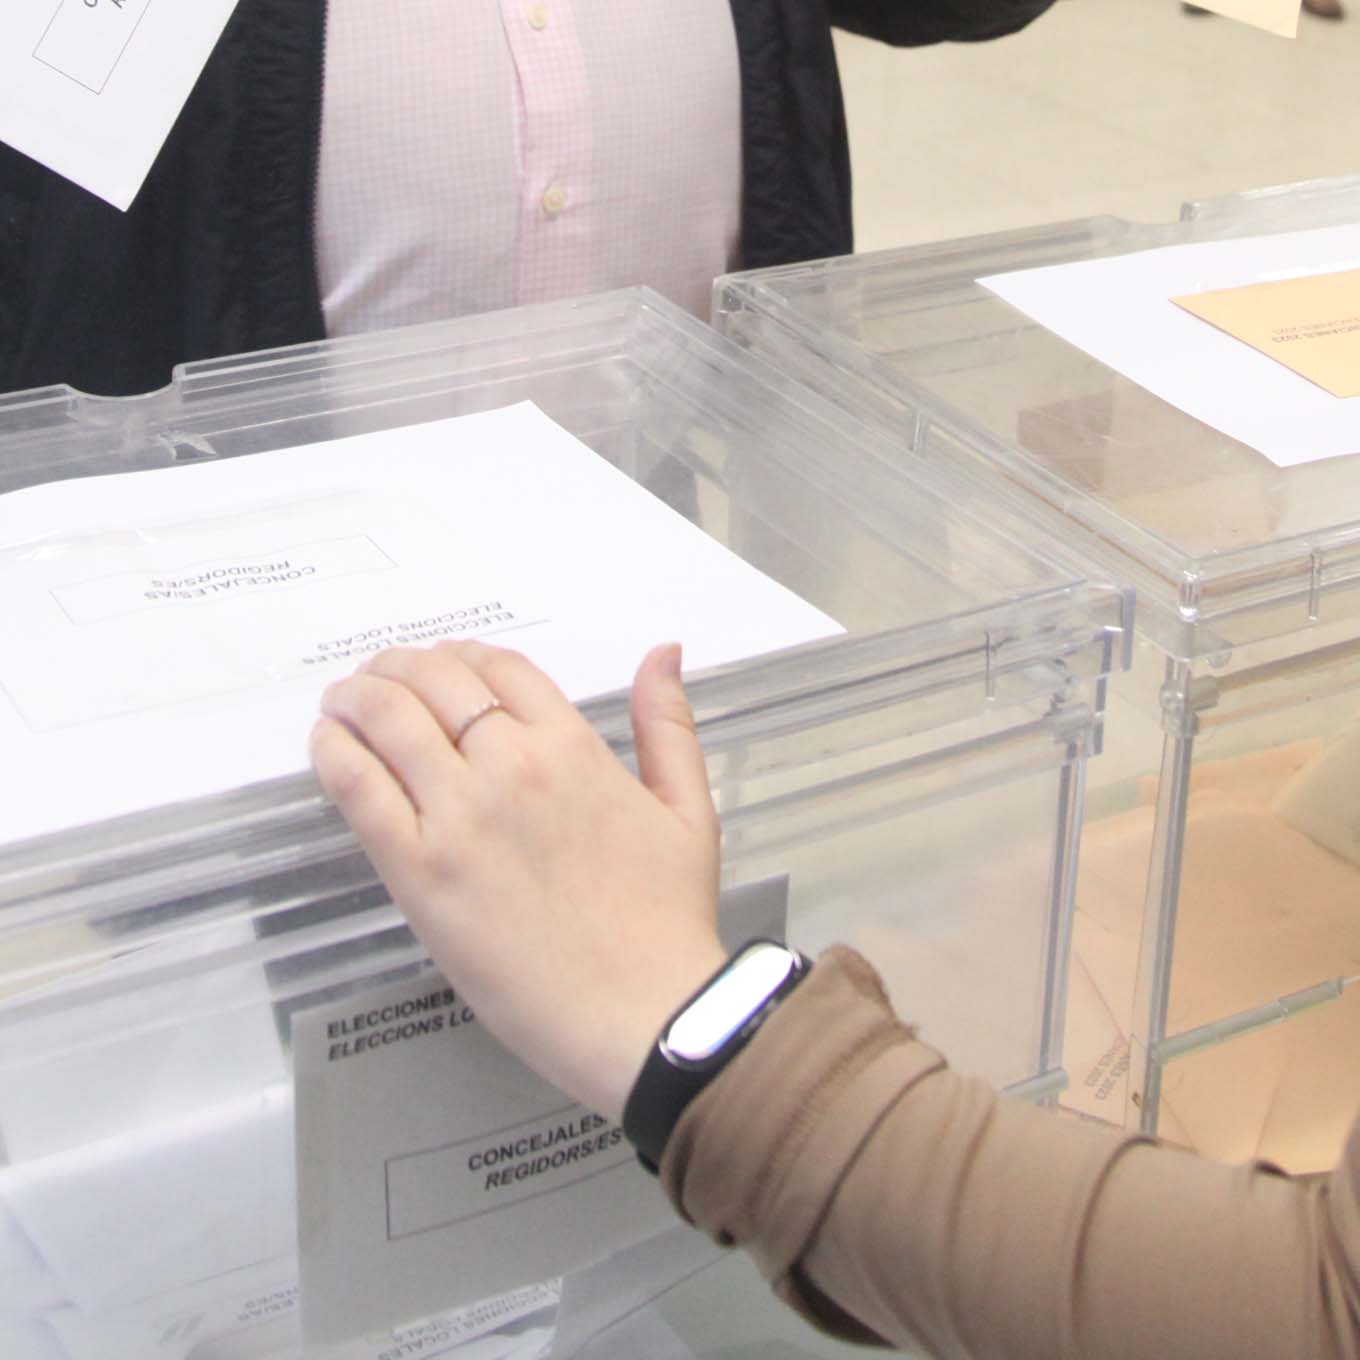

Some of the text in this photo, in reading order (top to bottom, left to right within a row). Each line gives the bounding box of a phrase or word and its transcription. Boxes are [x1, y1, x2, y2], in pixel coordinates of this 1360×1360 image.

[144, 566, 316, 599] CONCEJALES/AS
[151, 560, 290, 588] REGIDORS/ES
[317, 601, 502, 652] ELECCIONS LOCALS
[327, 987, 455, 1038] ELECCIONES
[329, 1015, 444, 1062] ELECCIONS
[485, 1128, 623, 1190] REGIDORS/ES
